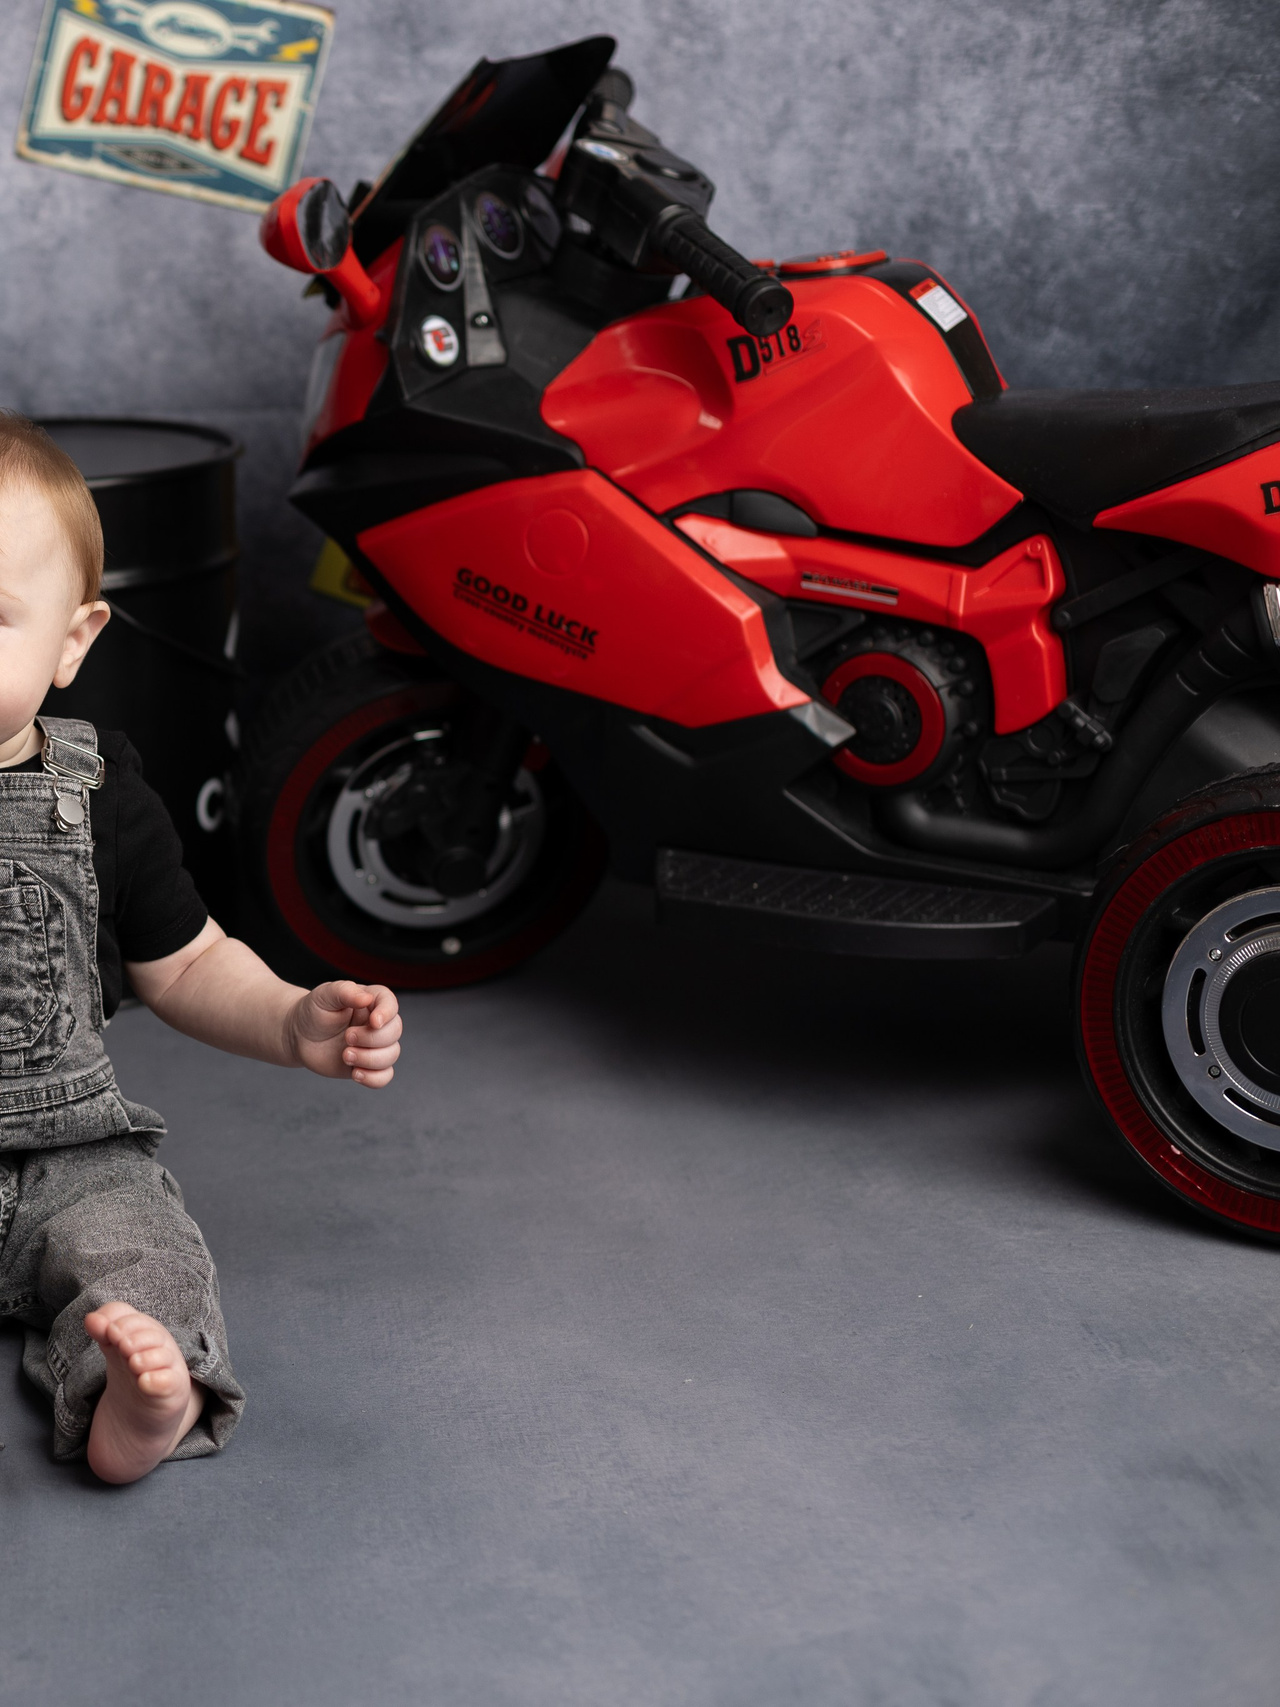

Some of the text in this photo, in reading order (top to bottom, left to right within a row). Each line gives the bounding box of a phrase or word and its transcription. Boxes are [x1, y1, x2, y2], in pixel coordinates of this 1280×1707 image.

[59, 35, 290, 168] GARAGE
[455, 566, 600, 648] GOOD LUCK
